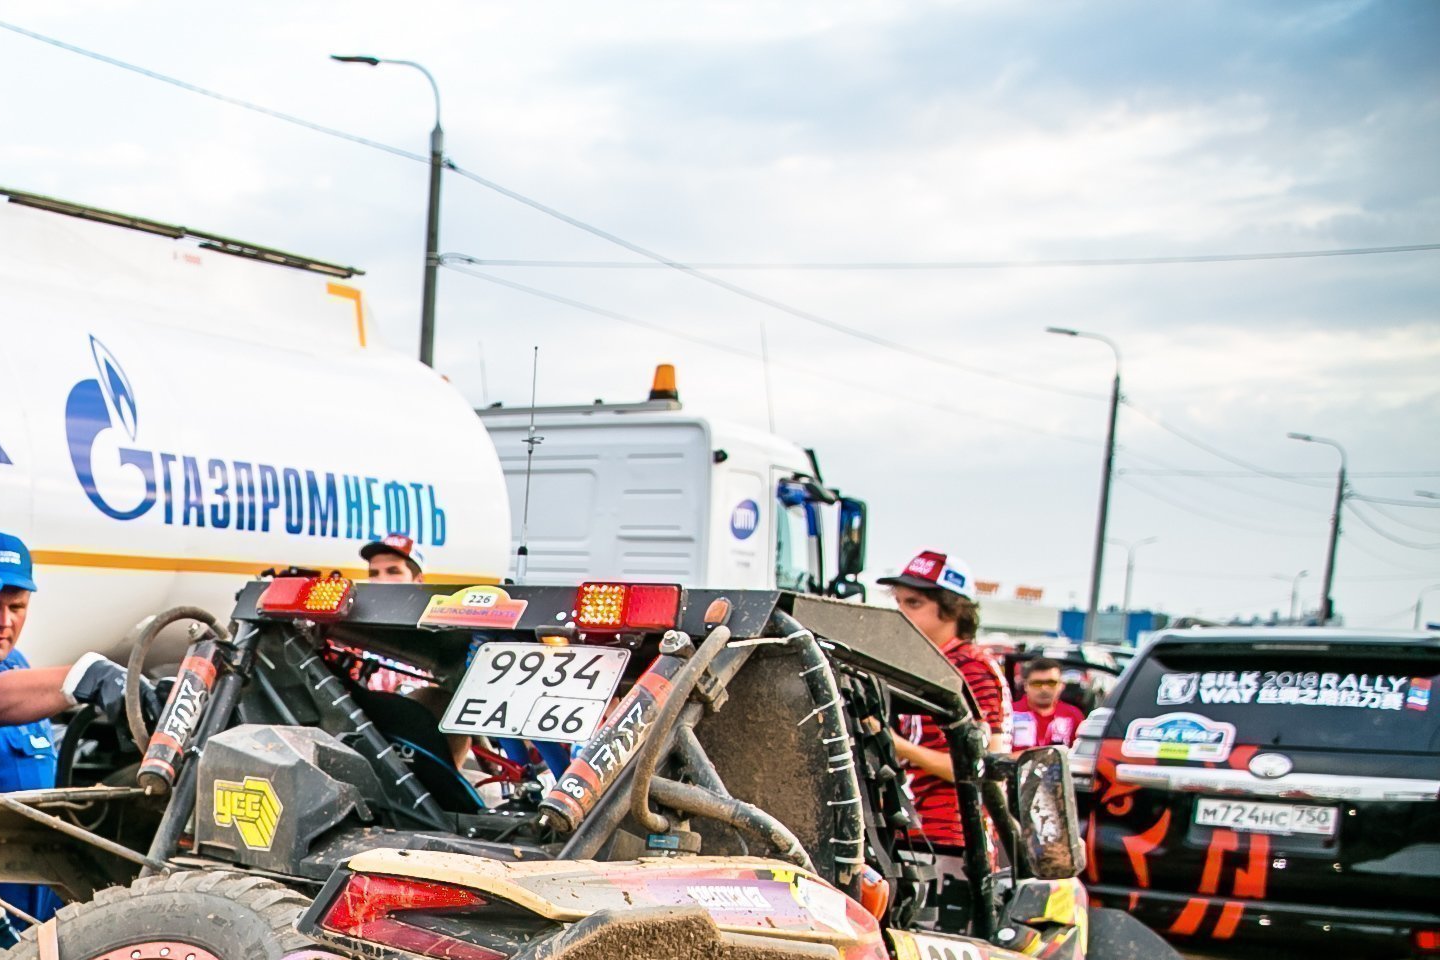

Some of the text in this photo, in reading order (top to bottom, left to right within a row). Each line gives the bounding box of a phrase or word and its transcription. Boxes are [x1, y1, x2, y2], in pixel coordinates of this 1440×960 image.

[160, 452, 447, 547] ГАЗПРОМНЕФТЬ
[468, 594, 491, 604] 226
[487, 651, 605, 690] 9934
[1201, 671, 1407, 693] SILK 2018 RALLY
[1200, 687, 1258, 704] WAY
[537, 705, 585, 734] 66
